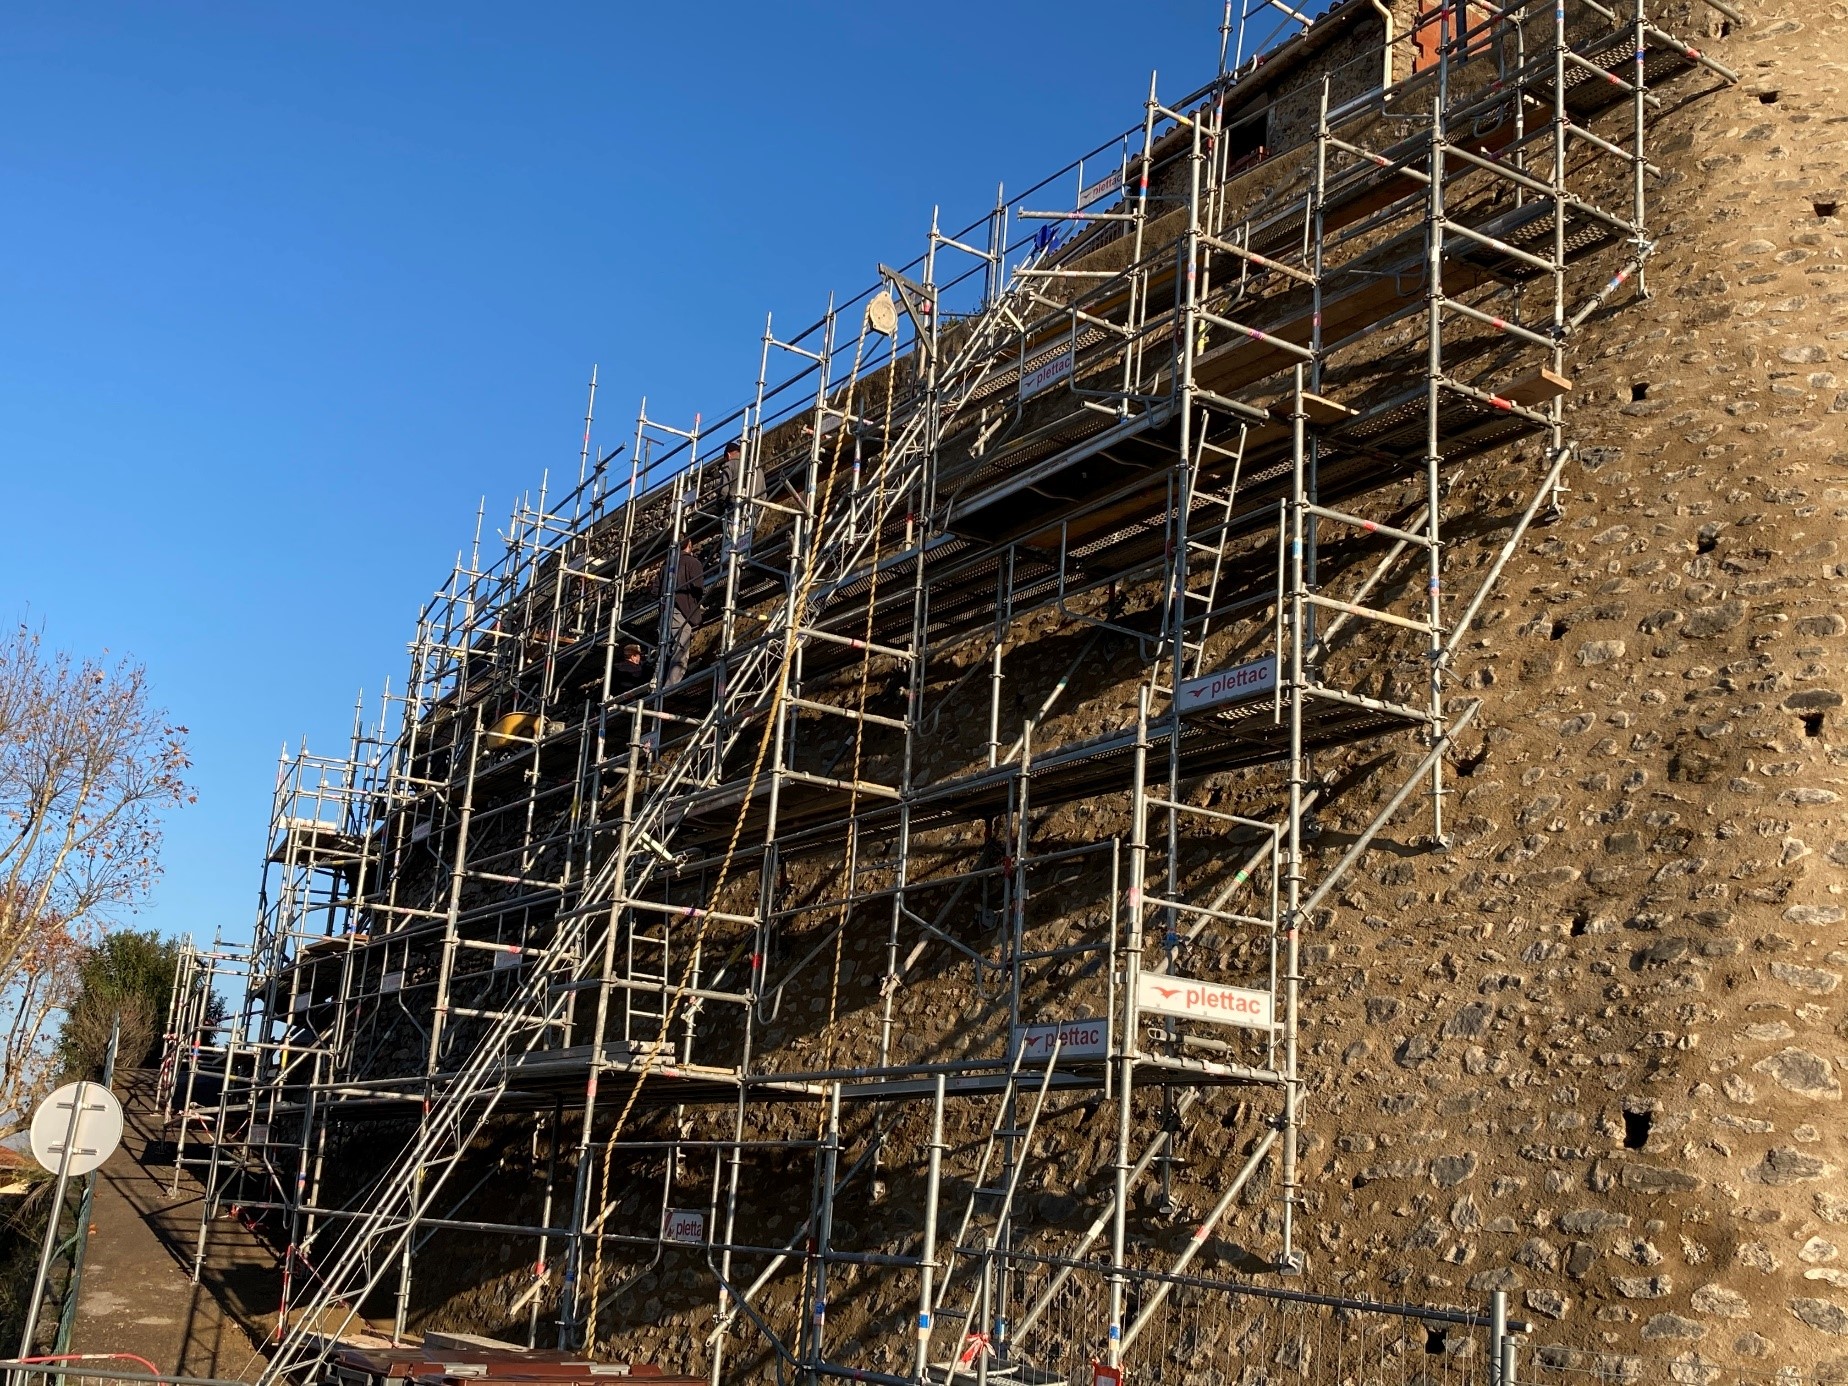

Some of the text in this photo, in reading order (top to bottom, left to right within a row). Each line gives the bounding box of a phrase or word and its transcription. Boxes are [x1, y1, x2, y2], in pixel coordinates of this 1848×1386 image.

[1036, 357, 1071, 388] plettac
[1211, 666, 1268, 699] plettac
[1186, 987, 1261, 1014] plettac
[1045, 1026, 1099, 1052] pettac
